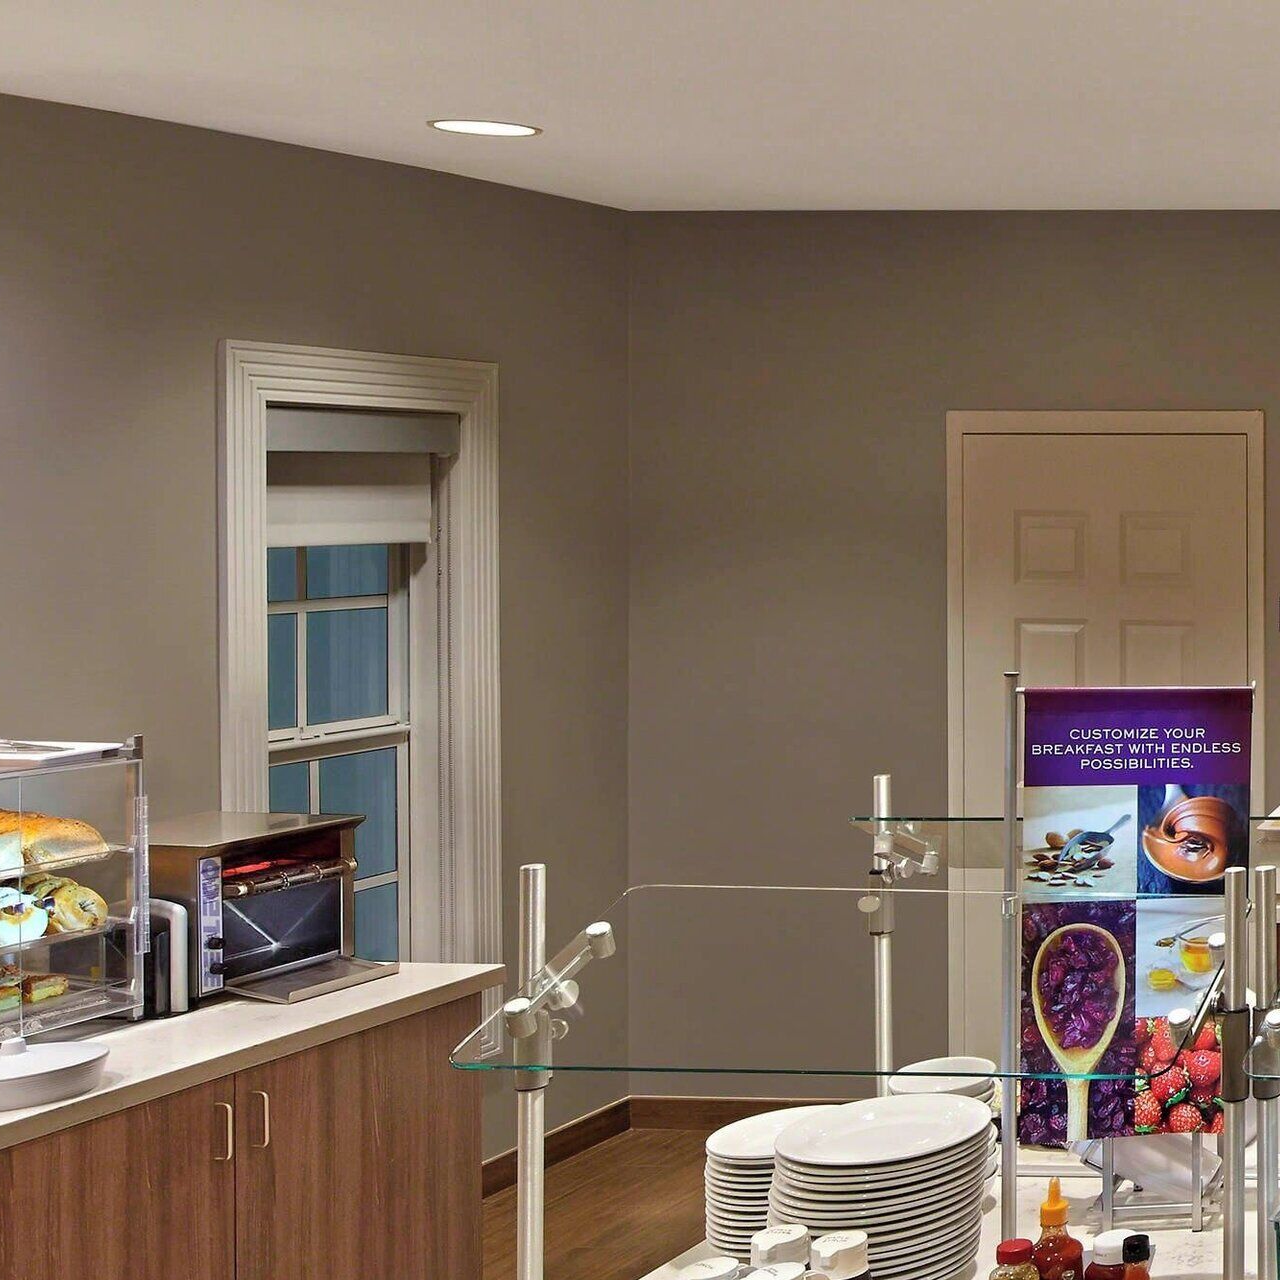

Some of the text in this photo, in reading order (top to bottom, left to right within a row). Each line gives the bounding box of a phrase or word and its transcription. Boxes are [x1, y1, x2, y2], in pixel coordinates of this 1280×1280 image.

[1069, 728, 1206, 740] CUSTOMIZE YOUR
[1031, 742, 1242, 756] BREAKFAST WITH ENDLESS
[1080, 757, 1194, 770] POSSIBILITIES.
